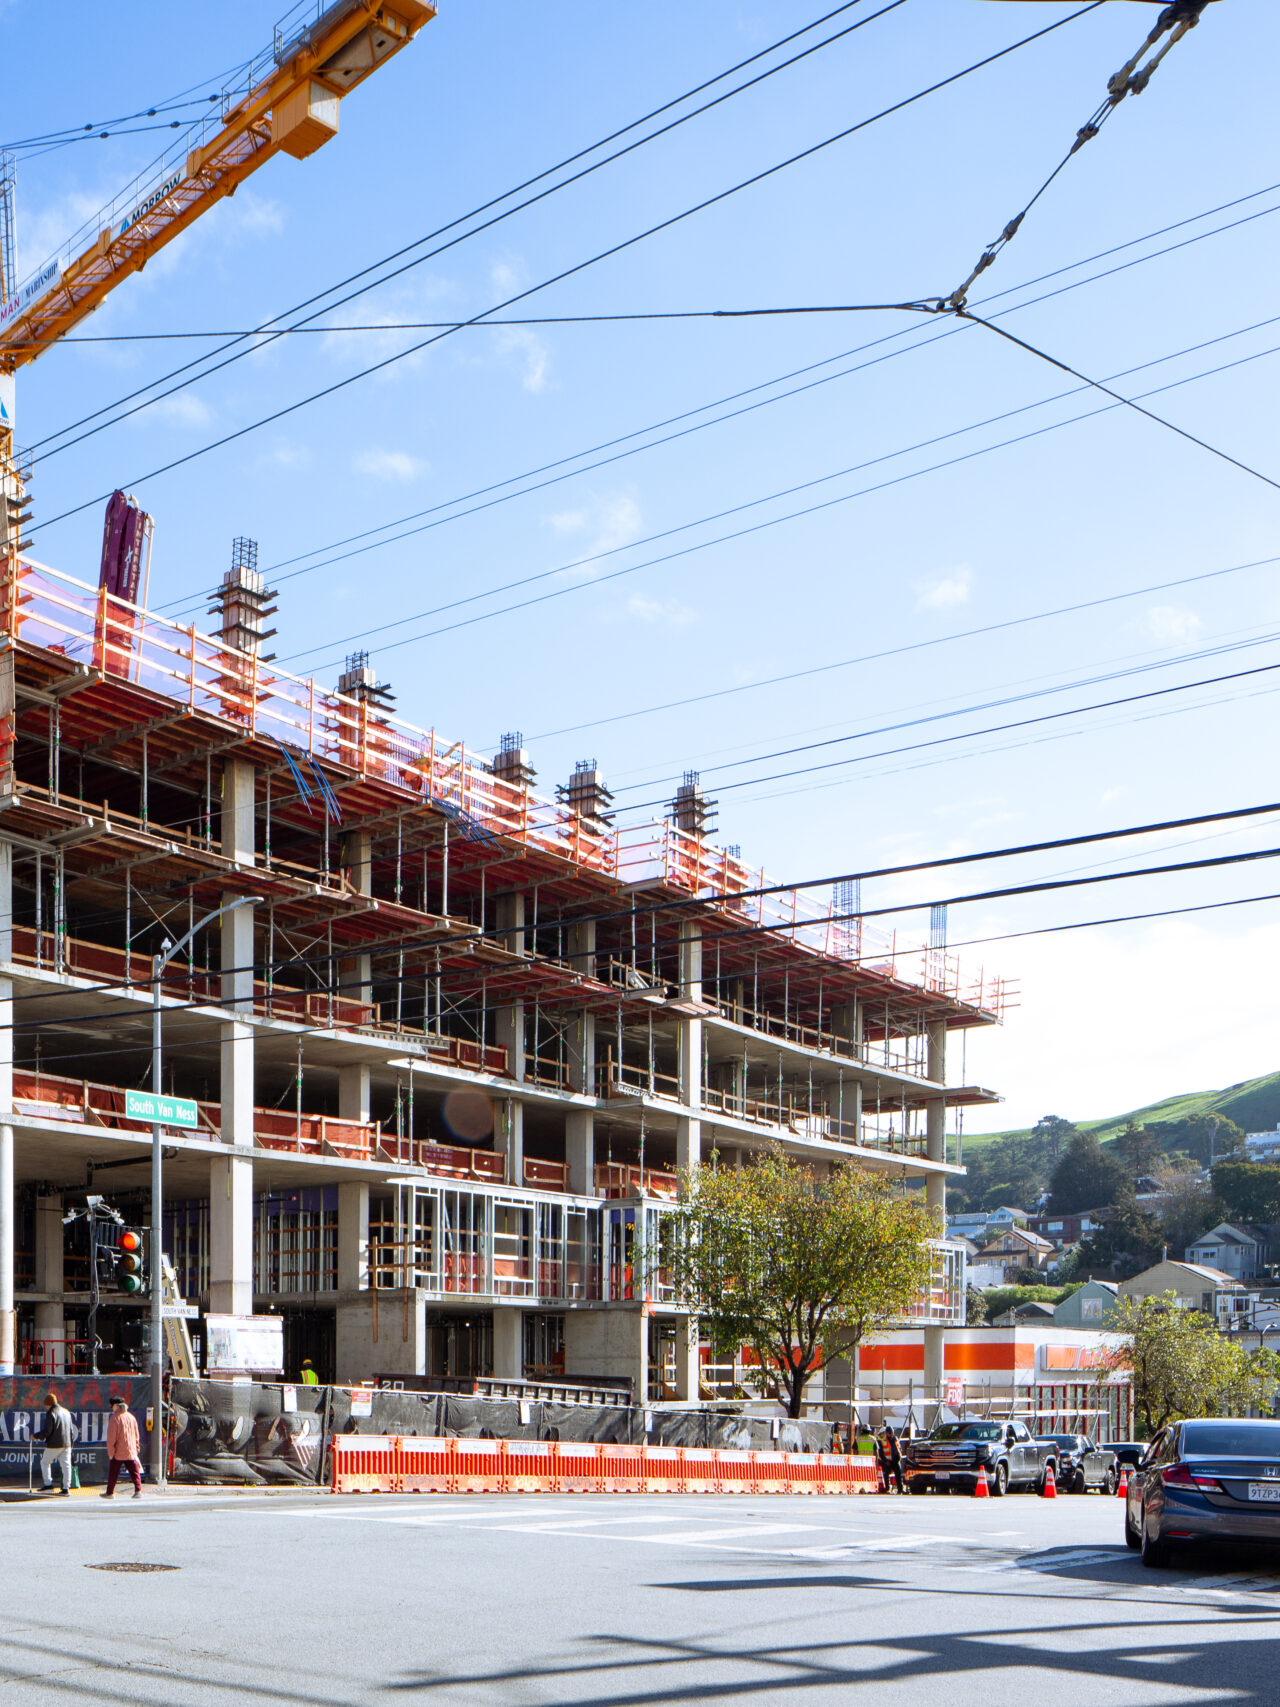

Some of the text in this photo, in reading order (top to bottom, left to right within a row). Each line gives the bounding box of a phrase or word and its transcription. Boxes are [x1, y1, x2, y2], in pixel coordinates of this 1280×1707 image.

[131, 173, 181, 223] MORROW
[129, 1097, 195, 1121] South Van Ness
[0, 1452, 38, 1464] JOINT
[1251, 1488, 1280, 1499] 9TZP3
